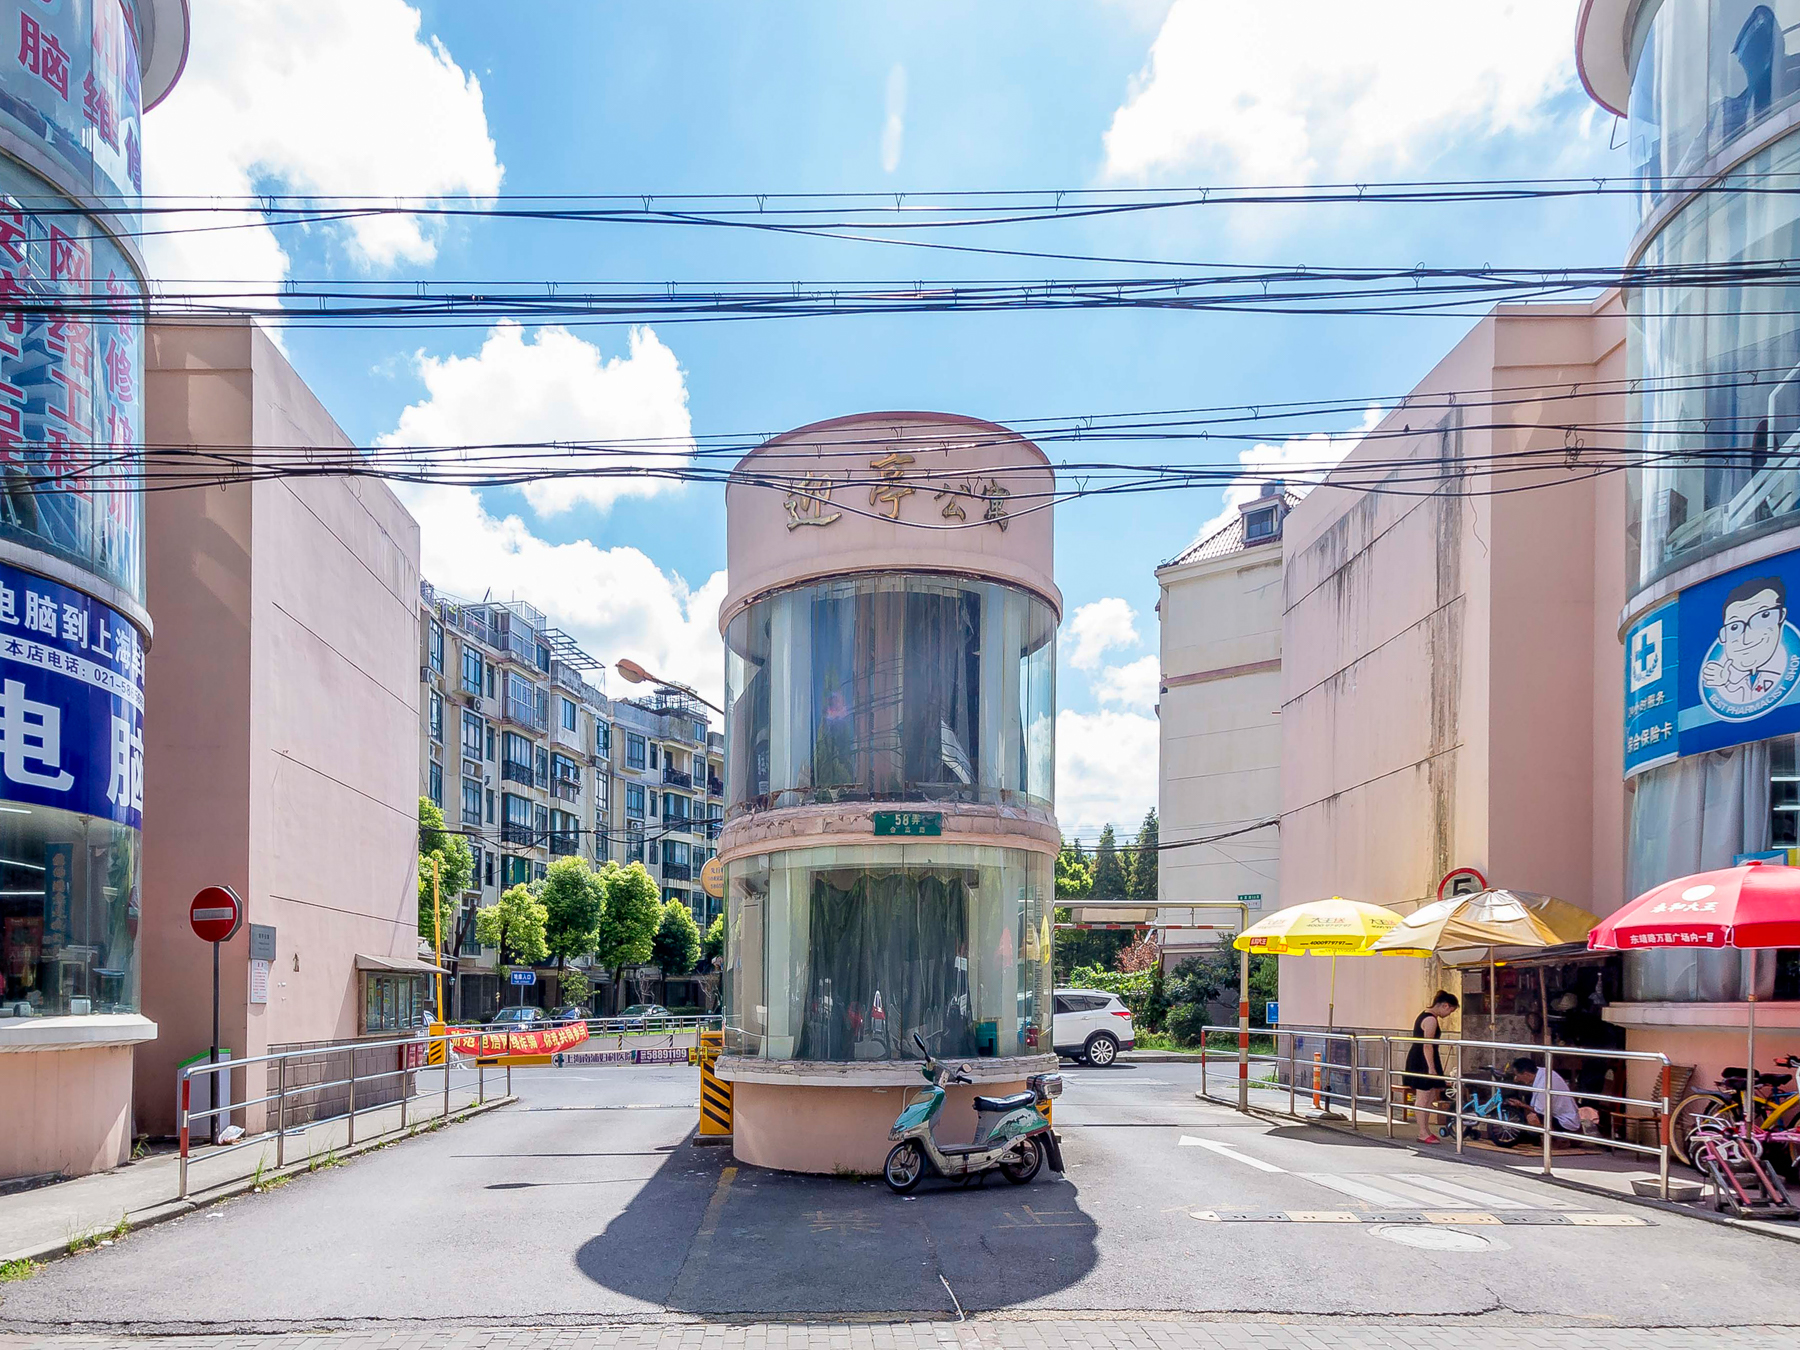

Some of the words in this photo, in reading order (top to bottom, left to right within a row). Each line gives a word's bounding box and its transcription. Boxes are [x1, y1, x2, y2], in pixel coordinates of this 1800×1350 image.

[1708, 694, 1727, 711] BEST
[1726, 684, 1787, 715] PHARMACIST
[1785, 655, 1800, 682] SHOP
[646, 1048, 687, 1060] 58891199
